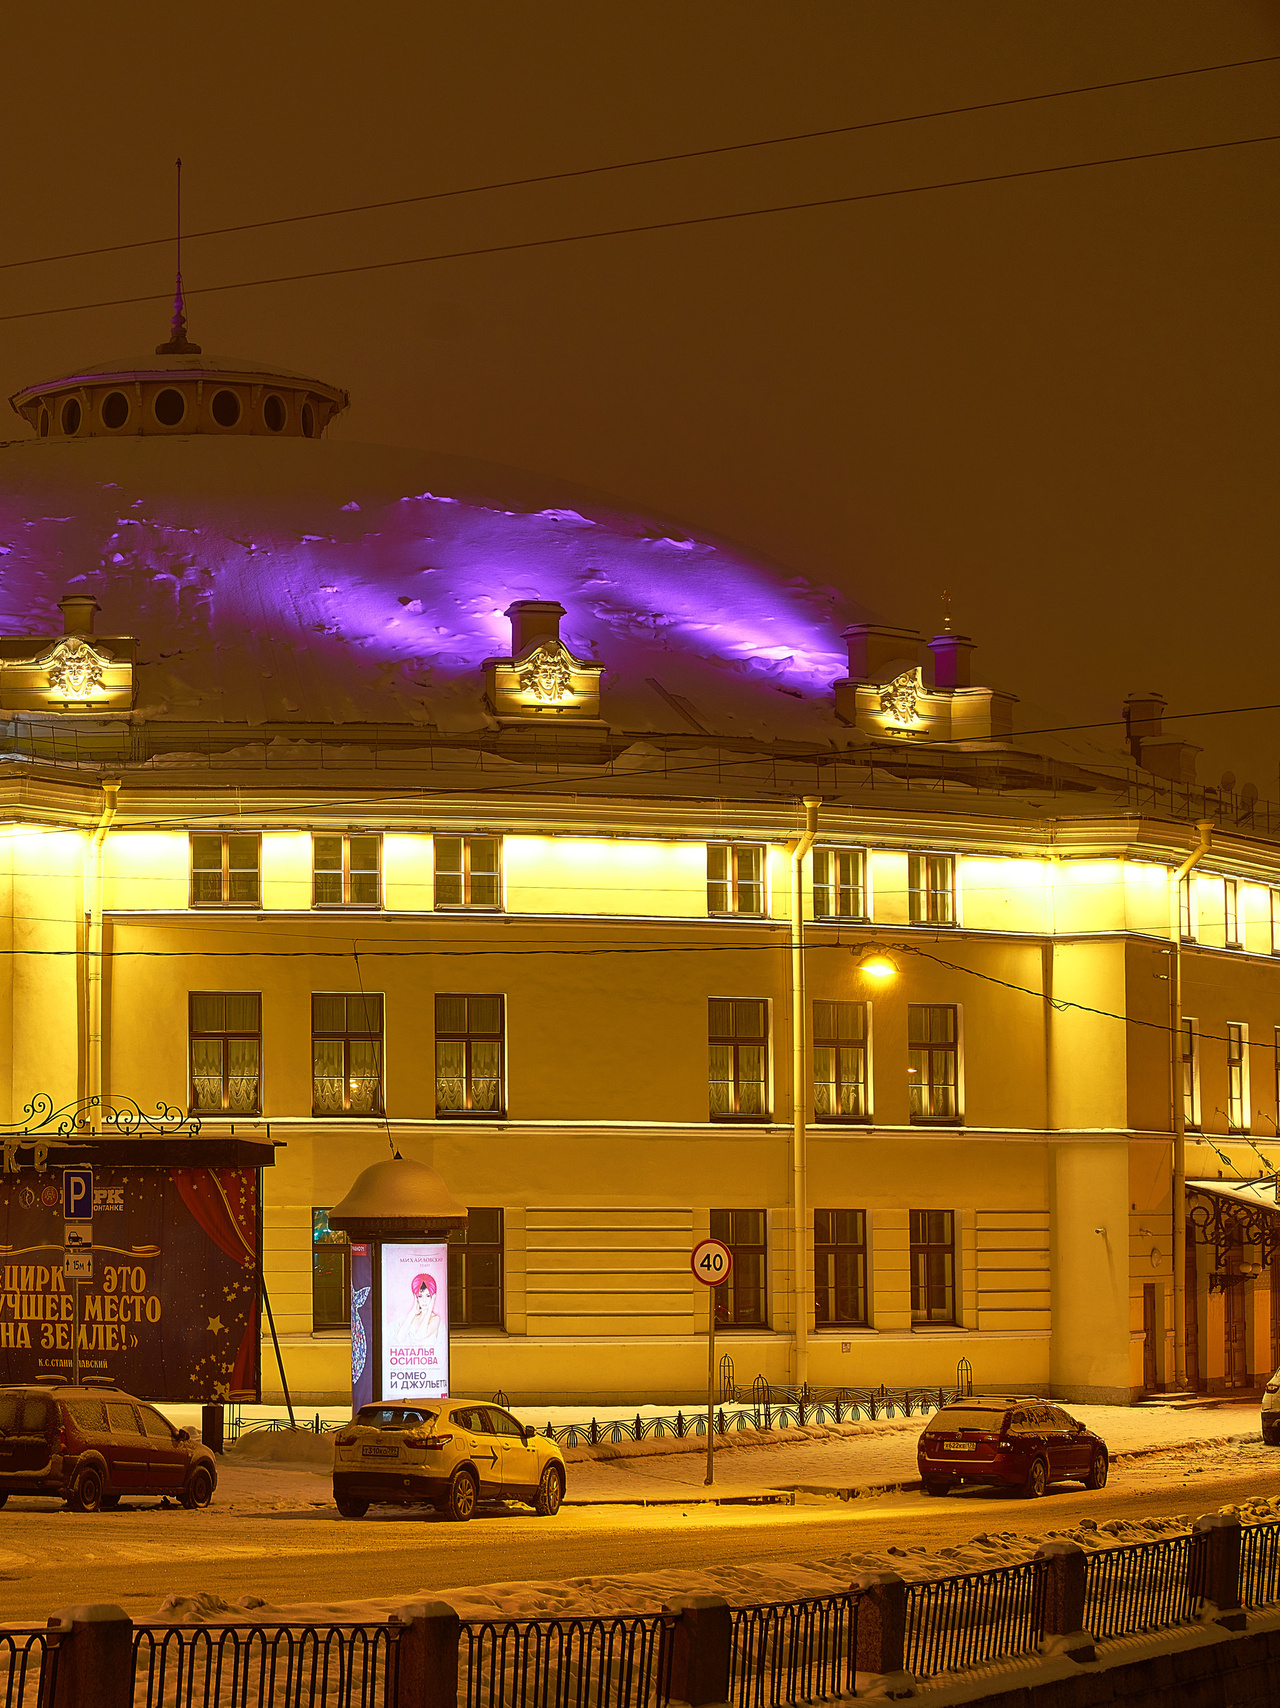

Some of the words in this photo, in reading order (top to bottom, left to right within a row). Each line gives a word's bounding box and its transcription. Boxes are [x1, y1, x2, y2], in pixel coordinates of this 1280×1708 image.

[70, 1176, 86, 1213] P
[94, 1204, 124, 1212] ОНТАНКЕ
[700, 1253, 723, 1271] 40
[102, 1266, 147, 1293] ЭТО
[84, 1295, 162, 1323] МЕСТО
[0, 1322, 32, 1349] НА
[390, 1348, 434, 1356] НАТАЛЬЯ
[390, 1357, 438, 1365] ОСИПОВА
[390, 1371, 427, 1380] РОМЕО
[390, 1381, 398, 1389] И
